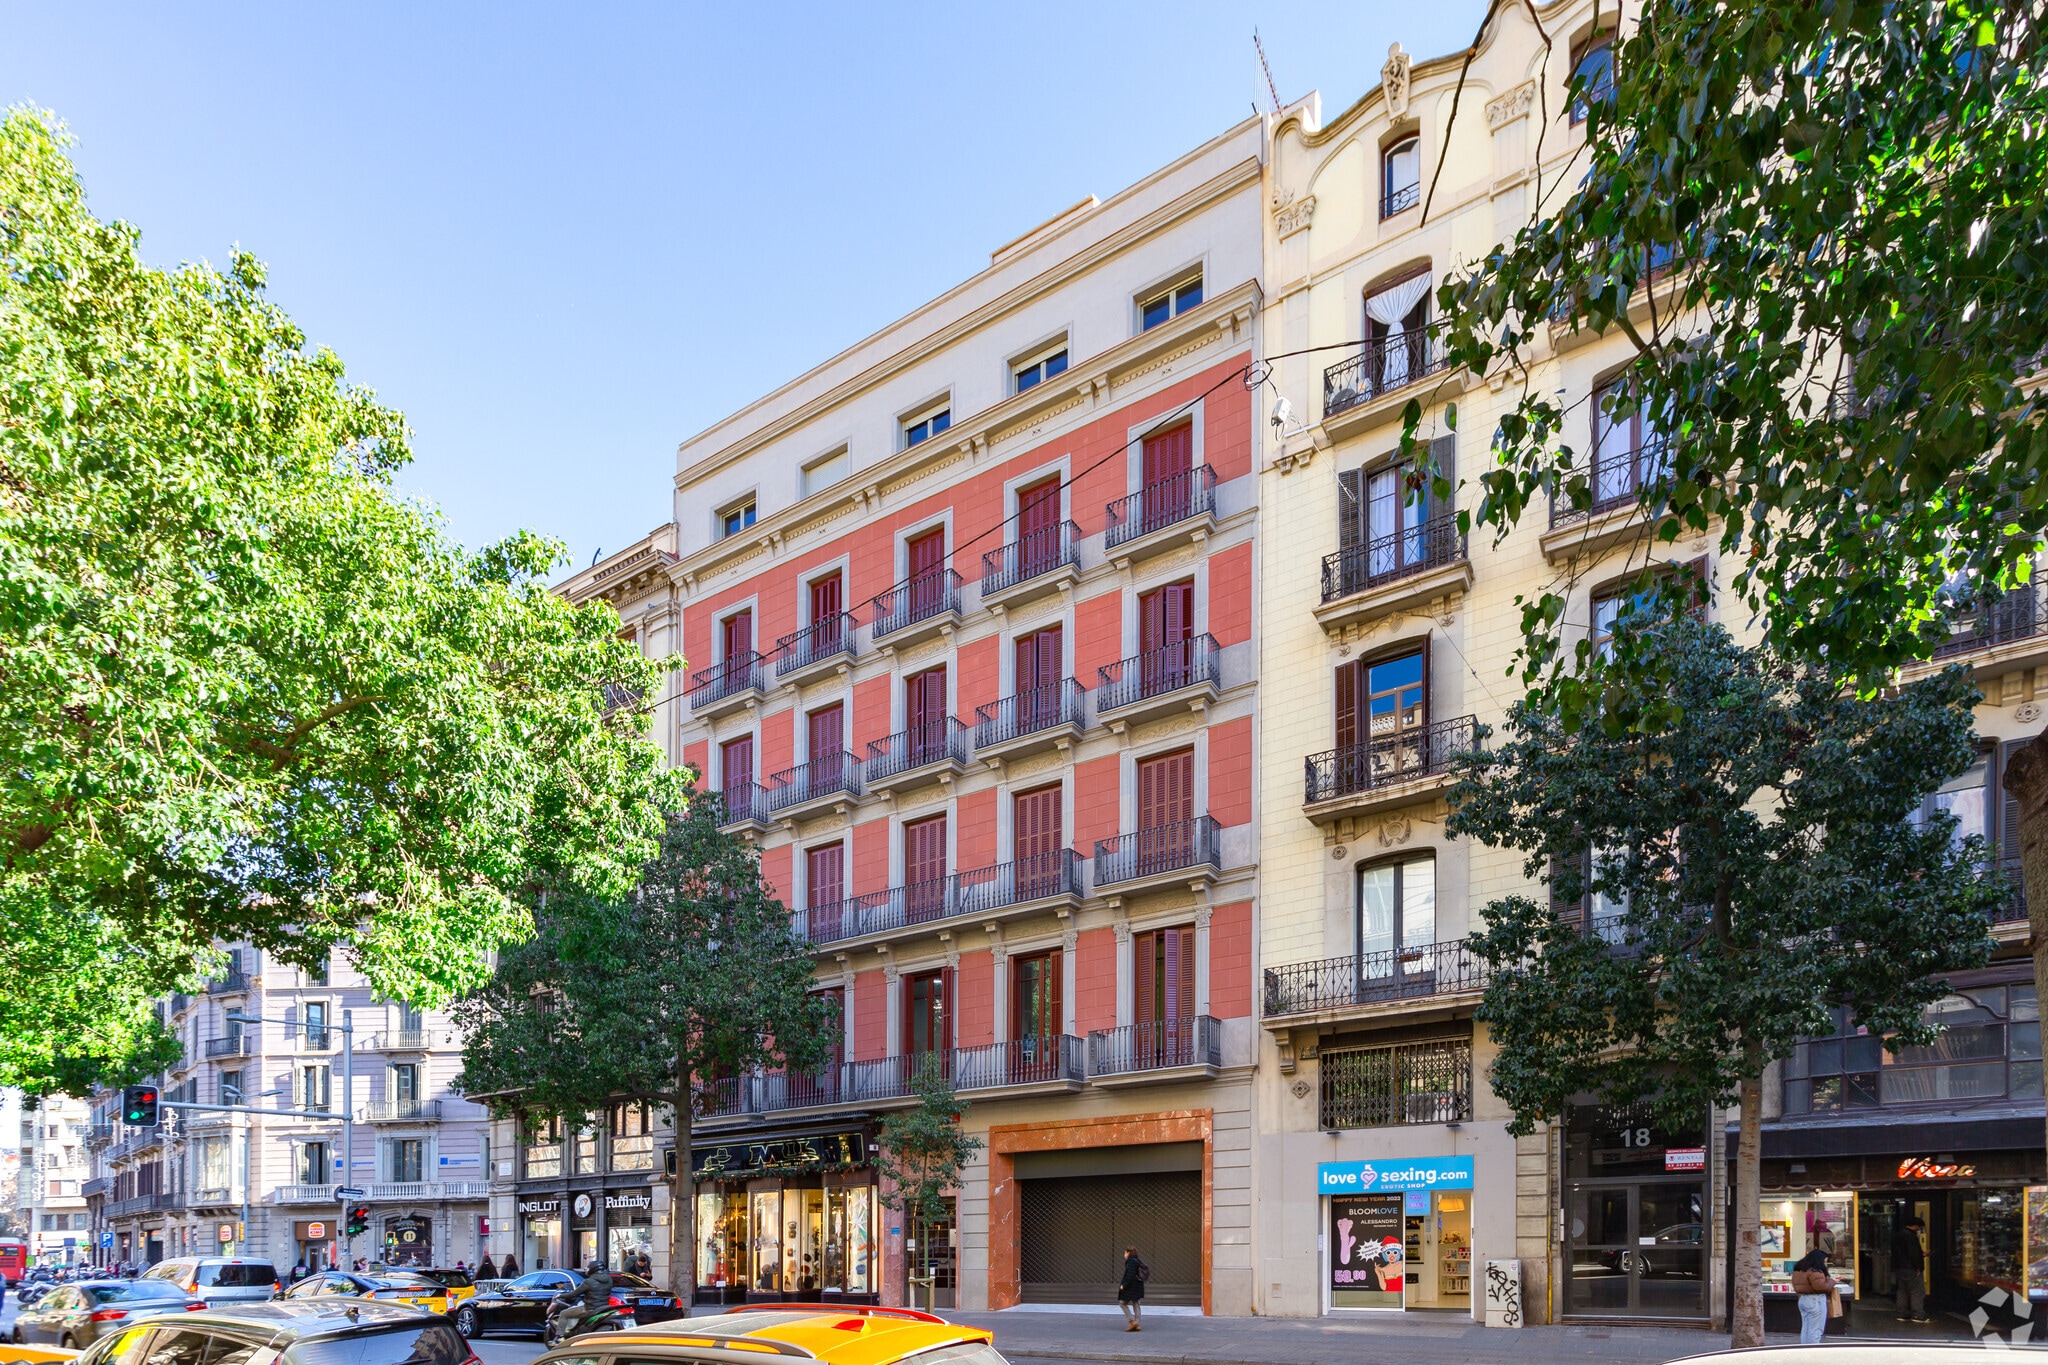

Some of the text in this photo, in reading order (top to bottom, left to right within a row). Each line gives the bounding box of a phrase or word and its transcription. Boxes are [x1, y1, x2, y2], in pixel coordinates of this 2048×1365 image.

[1620, 1128, 1651, 1147] 18
[1323, 1167, 1468, 1185] love sexing.com
[1897, 1157, 1977, 1179] Viena
[519, 1200, 559, 1213] INGLOT
[605, 1194, 651, 1210] Puffinity
[1348, 1207, 1398, 1216] BLOOMLOVE
[102, 1233, 112, 1242] P
